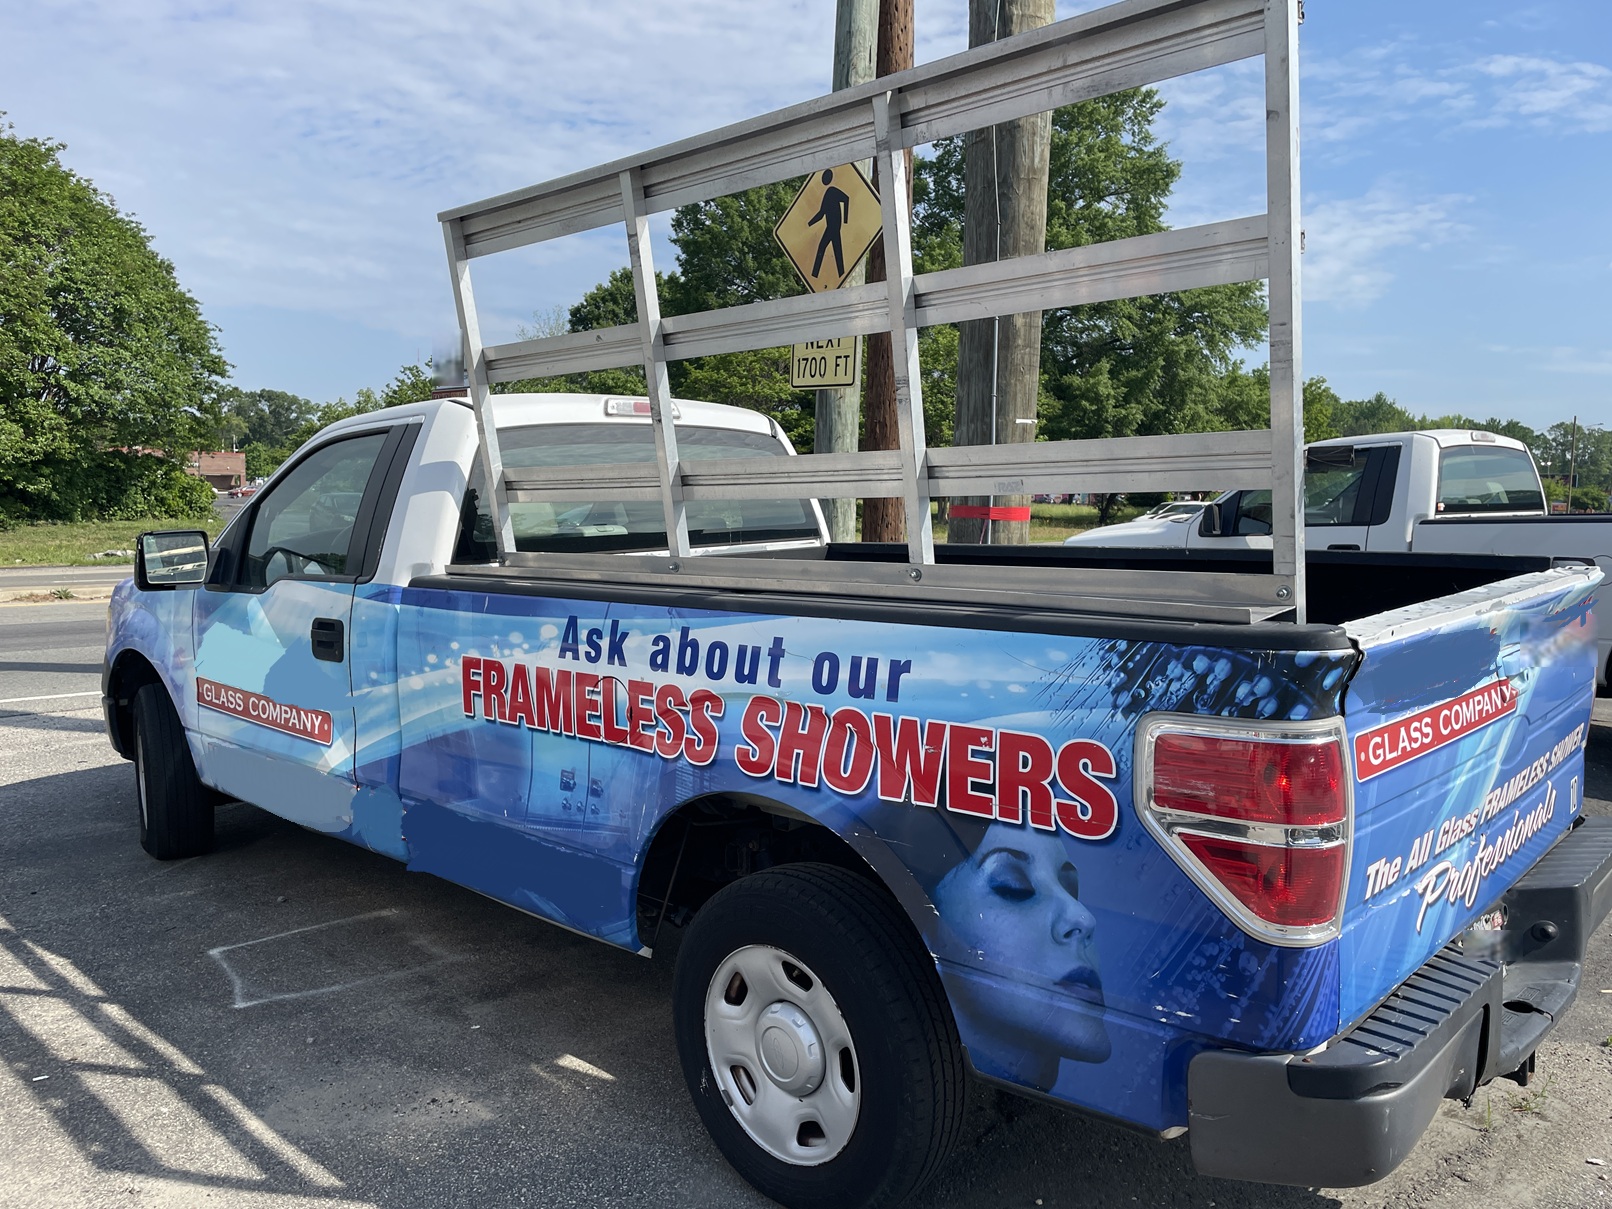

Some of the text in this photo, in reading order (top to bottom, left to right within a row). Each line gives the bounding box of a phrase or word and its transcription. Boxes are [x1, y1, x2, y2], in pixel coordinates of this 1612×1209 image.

[797, 355, 850, 378] 1700 FT
[558, 615, 912, 702] Ask about our
[203, 683, 322, 735] GLASS COMPANY
[461, 655, 1119, 841] FRAMELESS SHOWERS
[1368, 683, 1512, 766] GLASS COMPANY
[1364, 722, 1585, 900] The All Glass FRAMELESS SHOWER
[1415, 780, 1557, 933] Professionals
